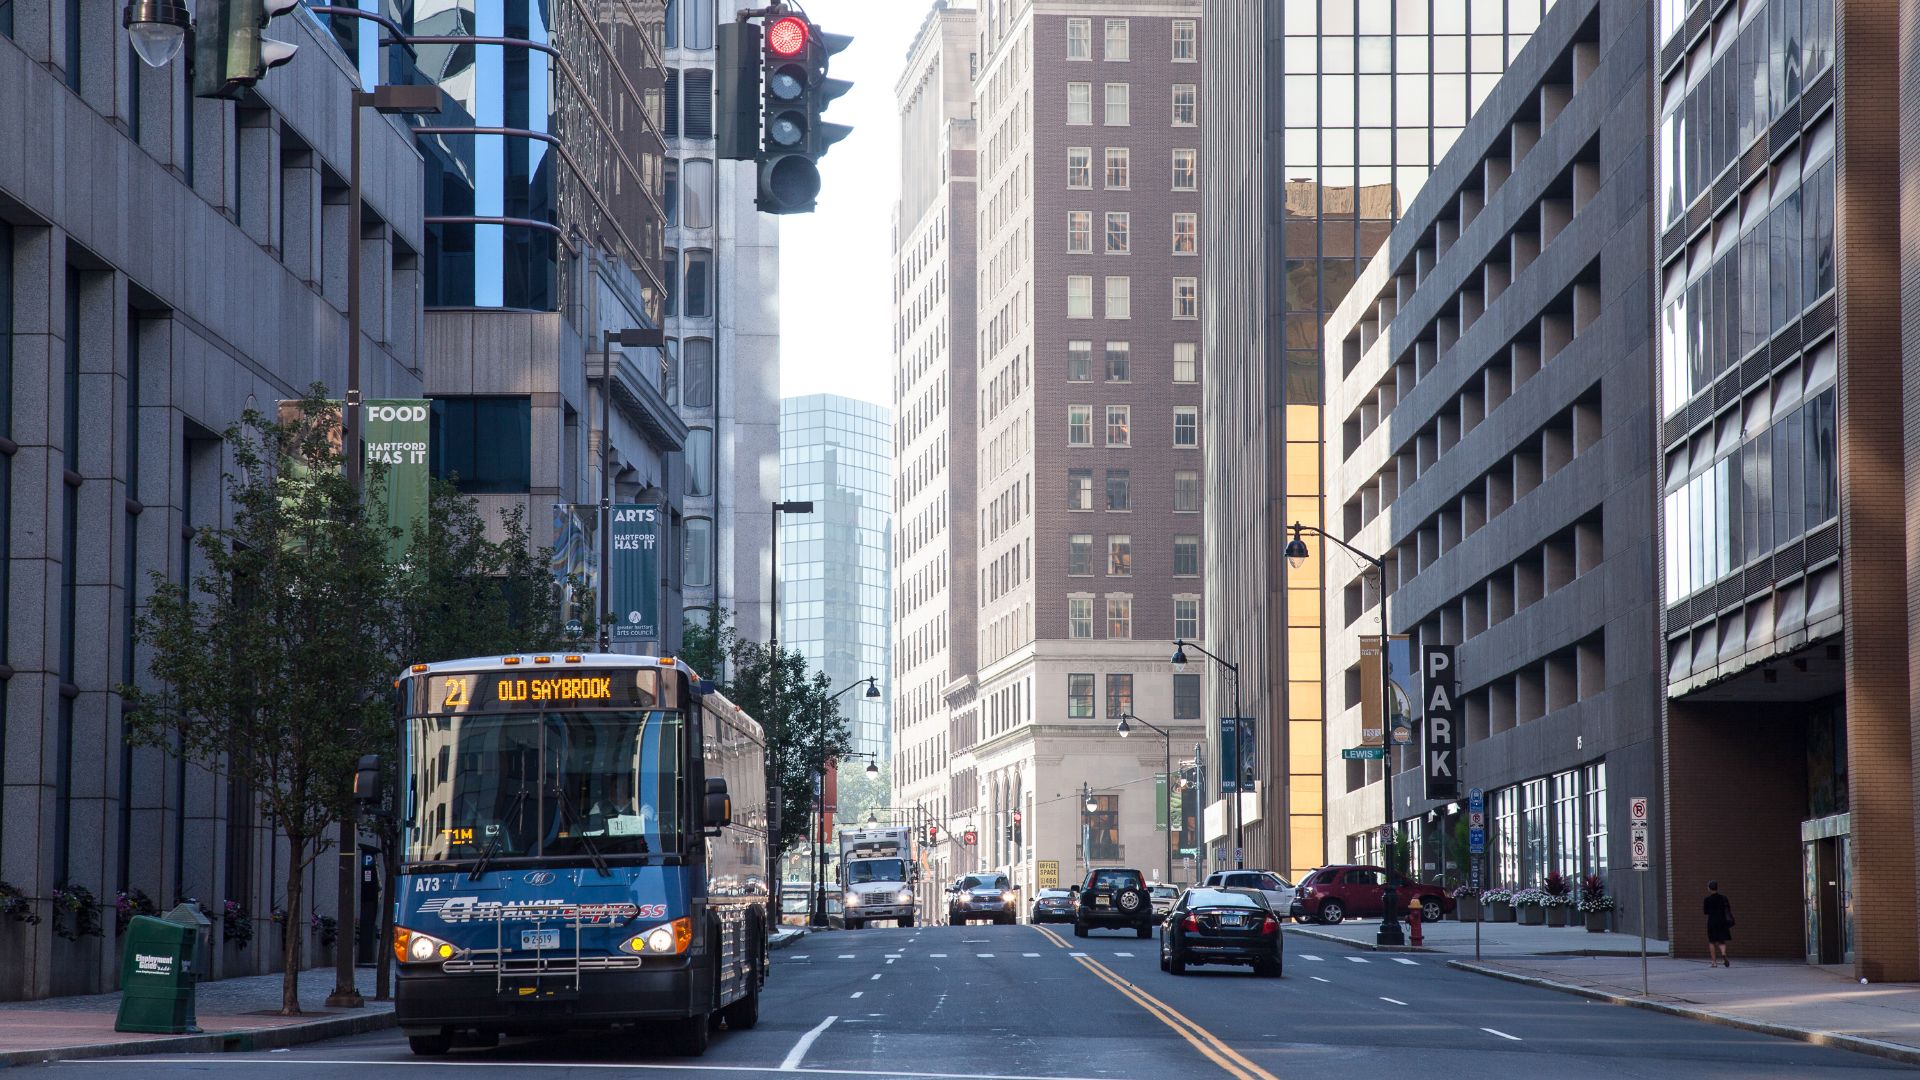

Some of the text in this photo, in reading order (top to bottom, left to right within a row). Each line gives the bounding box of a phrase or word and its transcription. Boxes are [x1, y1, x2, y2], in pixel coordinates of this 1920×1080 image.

[368, 406, 427, 422] FOOD
[367, 442, 427, 451] HARTFORD
[368, 451, 426, 465] HAS IT
[614, 509, 655, 522] ARTS
[614, 540, 655, 550] HAS IT
[445, 678, 468, 706] 21
[498, 678, 611, 701] OLD SAYBROOK
[1428, 651, 1452, 777] PARK
[1344, 750, 1374, 759] LEWIS
[365, 855, 373, 866] P
[416, 877, 440, 892] A73
[135, 954, 173, 965] Employment
